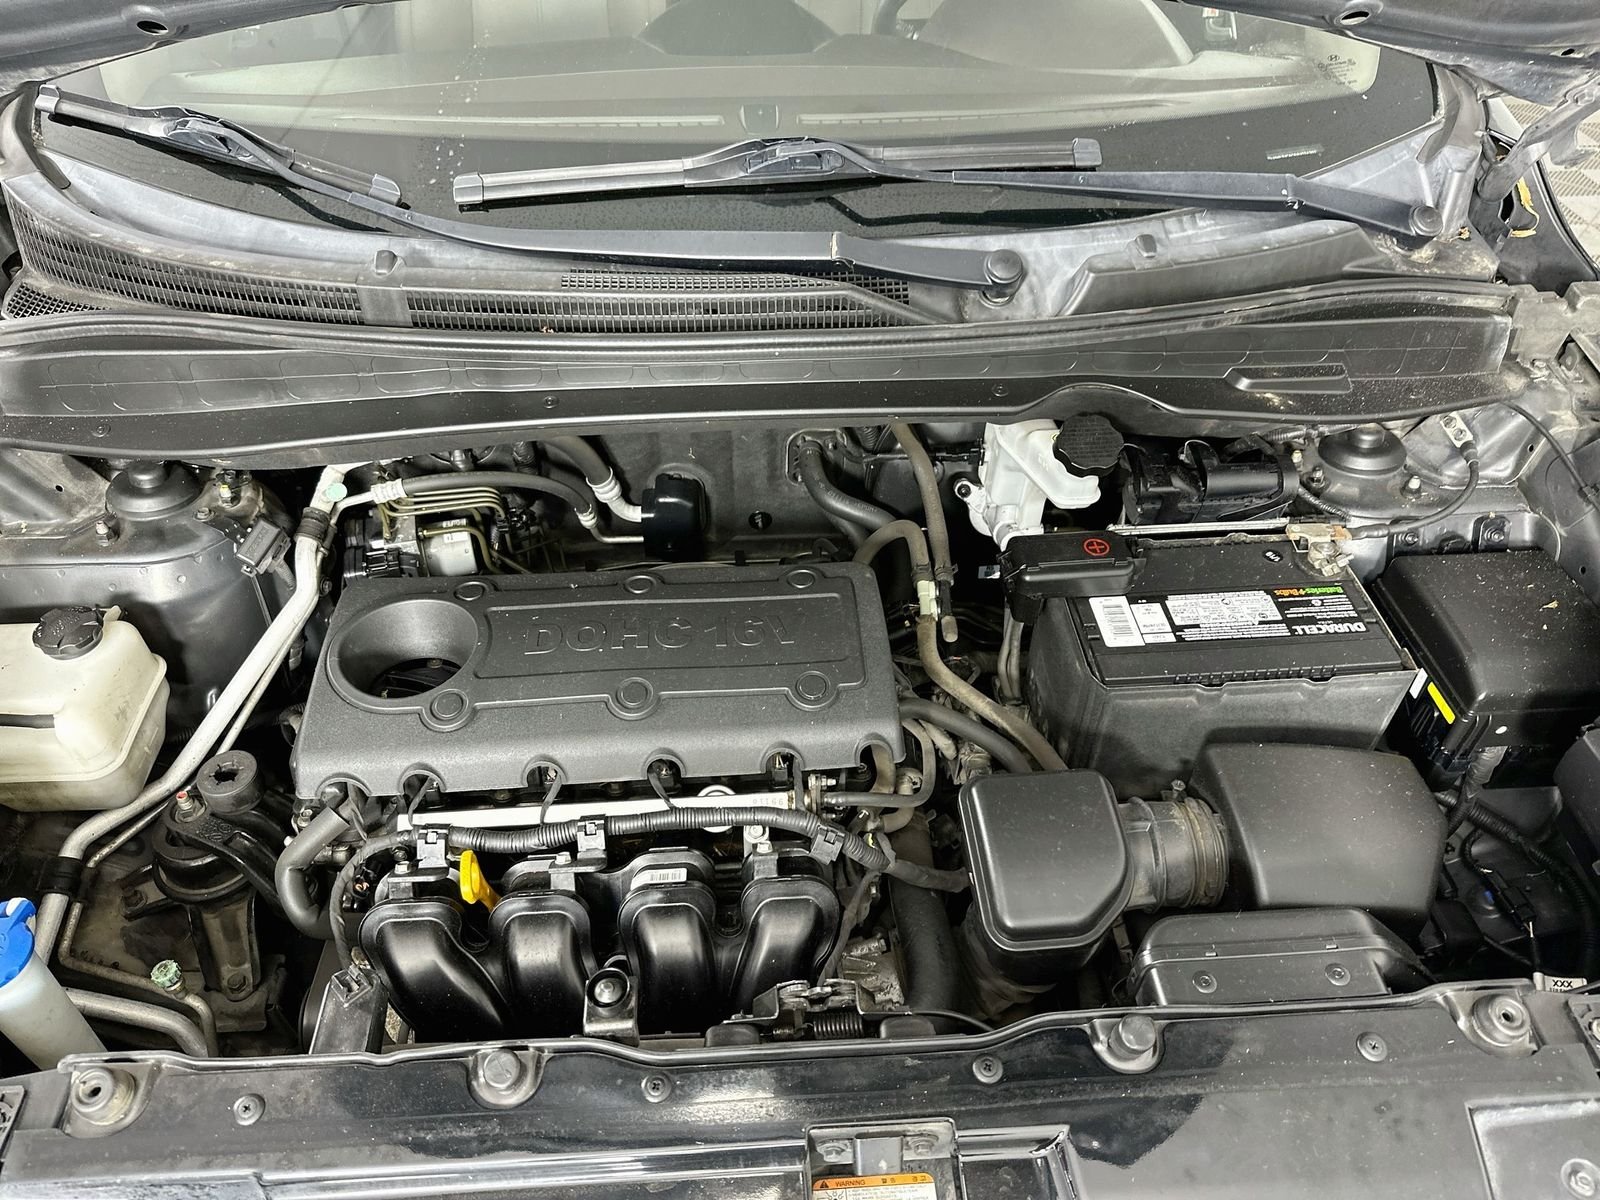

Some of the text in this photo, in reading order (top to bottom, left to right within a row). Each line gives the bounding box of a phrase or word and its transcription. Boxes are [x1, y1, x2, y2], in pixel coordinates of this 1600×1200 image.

[524, 612, 803, 655] DOHC 16V
[1291, 621, 1367, 636] DURACELL
[1551, 979, 1574, 988] XXX
[835, 1179, 866, 1188] WARNING
